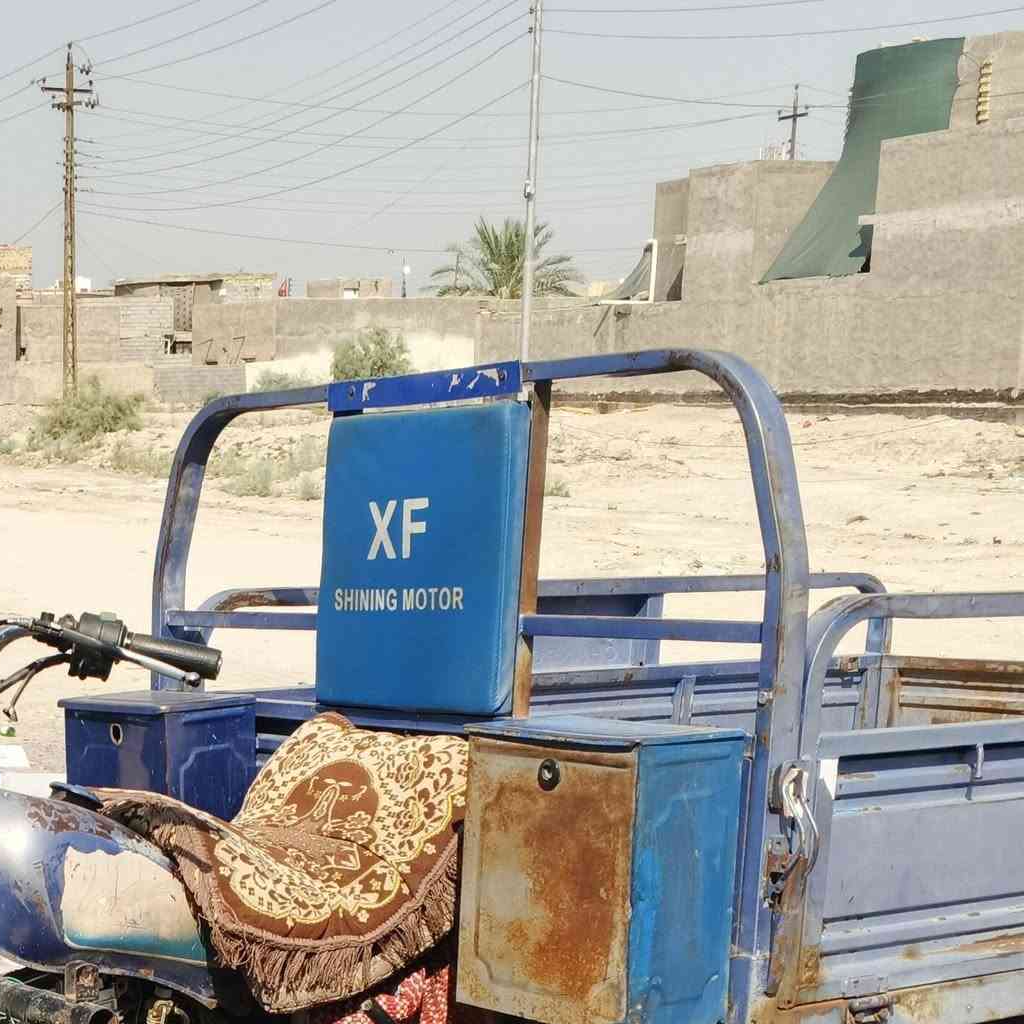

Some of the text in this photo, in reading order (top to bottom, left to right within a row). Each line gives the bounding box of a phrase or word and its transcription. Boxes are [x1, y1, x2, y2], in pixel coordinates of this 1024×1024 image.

[367, 497, 430, 561] XF
[334, 586, 464, 612] SHINING MOTOR
